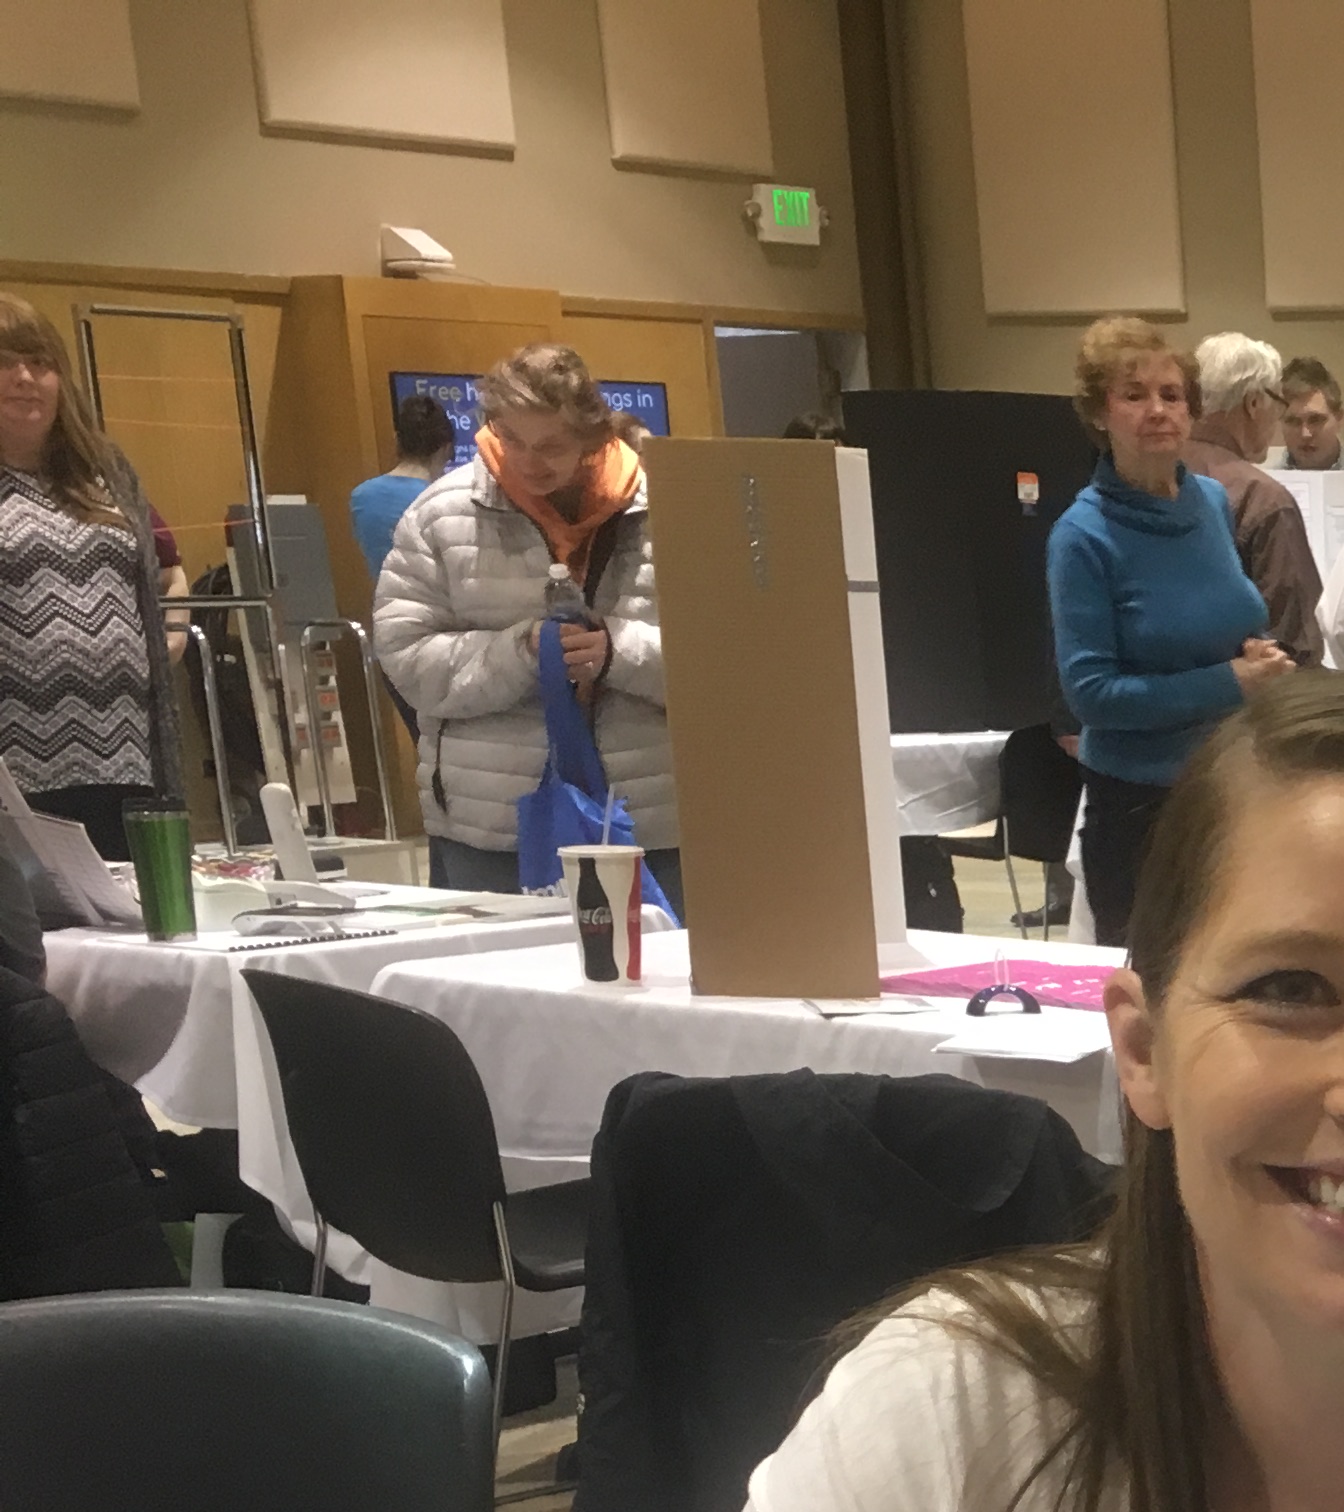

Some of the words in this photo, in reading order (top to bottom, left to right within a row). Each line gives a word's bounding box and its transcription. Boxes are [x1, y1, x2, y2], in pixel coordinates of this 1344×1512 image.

[772, 189, 810, 227] EXIT
[415, 379, 461, 401] Free
[637, 389, 654, 407] in
